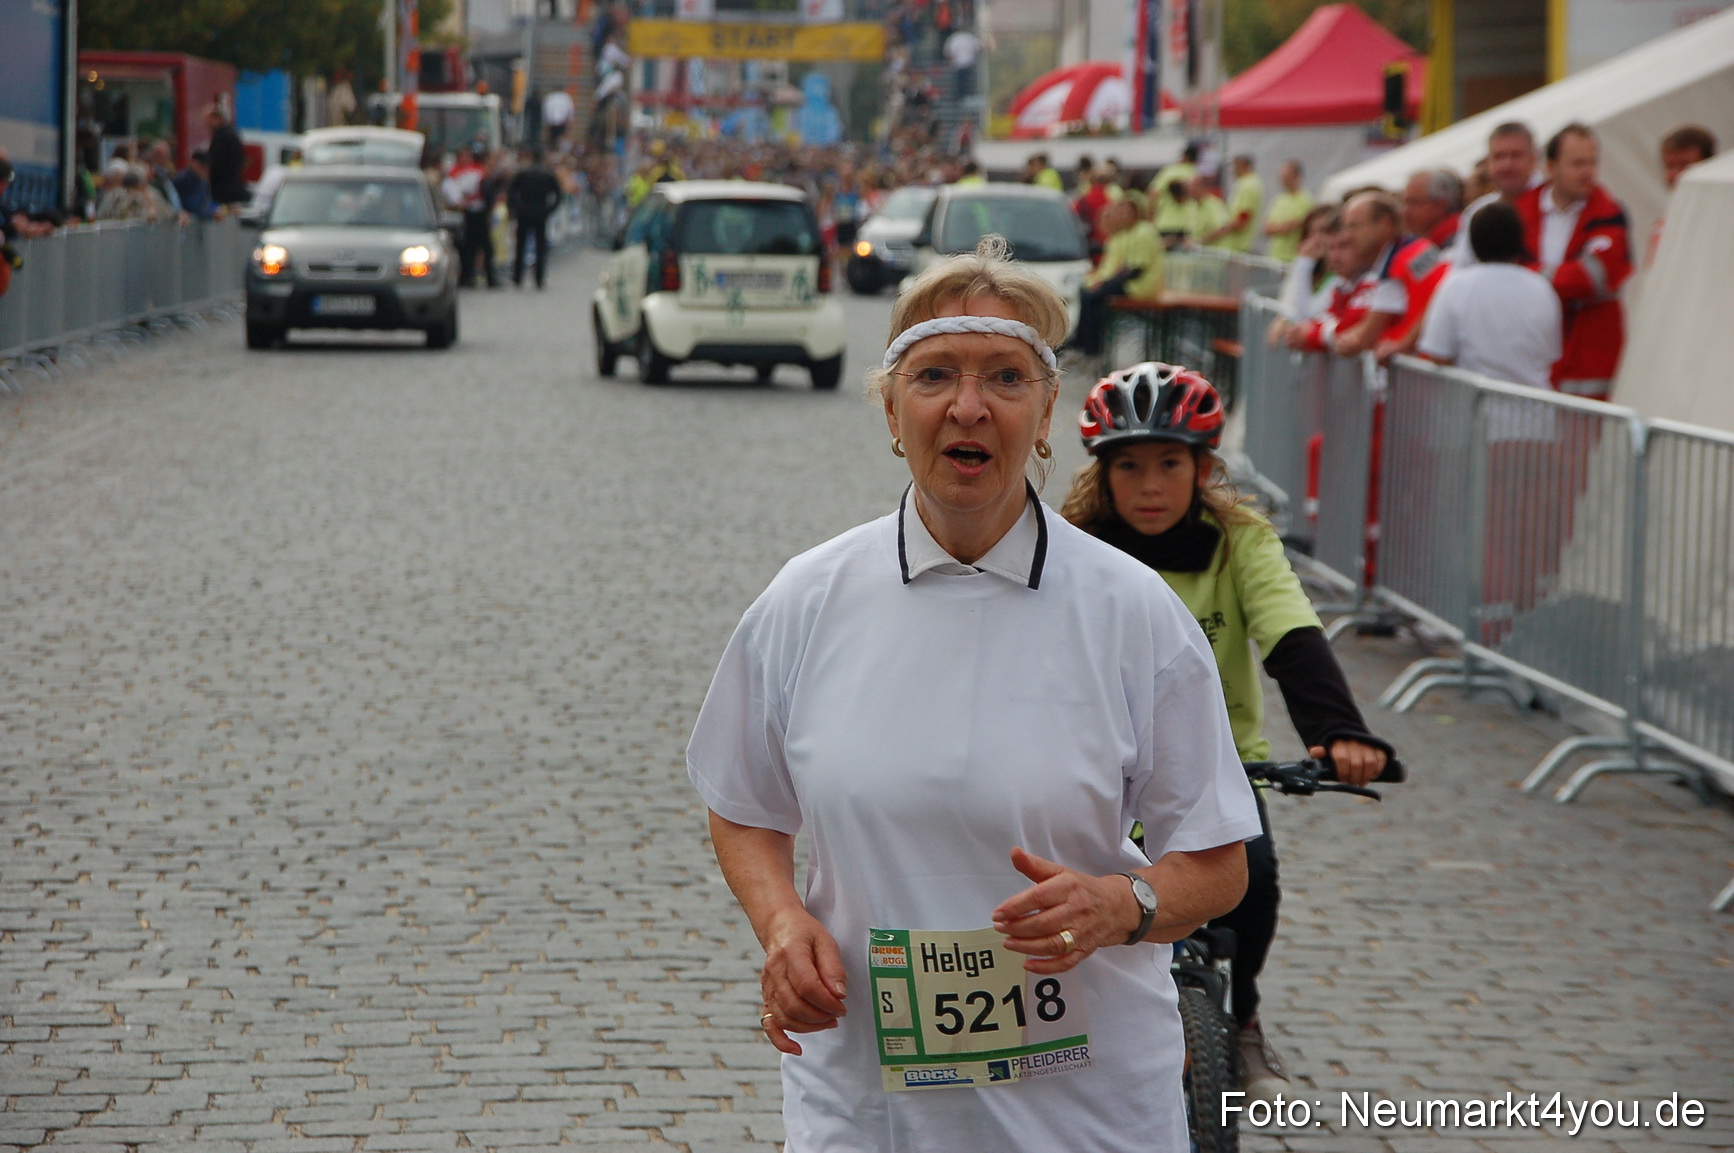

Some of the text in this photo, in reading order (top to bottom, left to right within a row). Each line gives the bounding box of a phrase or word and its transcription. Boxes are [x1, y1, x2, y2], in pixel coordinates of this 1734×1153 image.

[920, 942, 995, 978] Helga
[881, 991, 894, 1014] S
[934, 977, 1066, 1036] 5218
[1011, 1046, 1091, 1071] PFLEIDERER
[1013, 1060, 1093, 1080] AKTIENGESELLSCHAFT
[904, 1068, 958, 1082] BOCK
